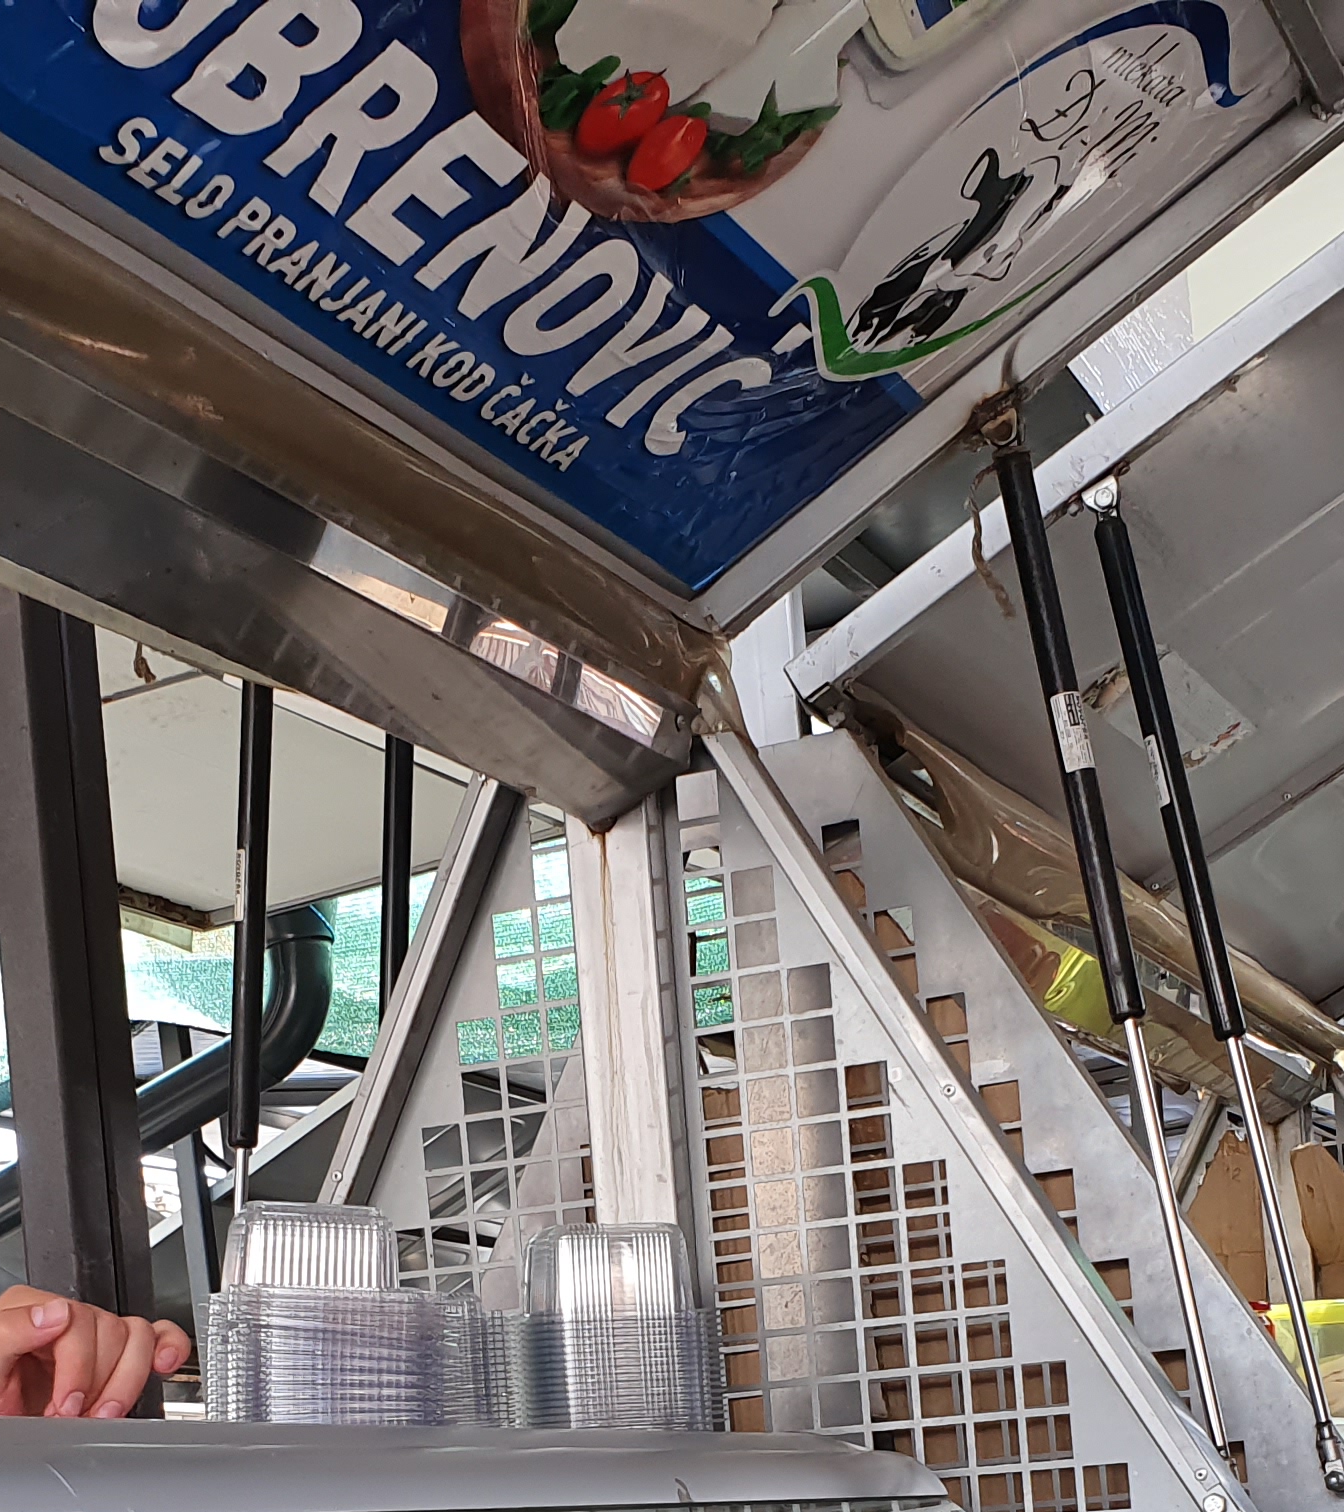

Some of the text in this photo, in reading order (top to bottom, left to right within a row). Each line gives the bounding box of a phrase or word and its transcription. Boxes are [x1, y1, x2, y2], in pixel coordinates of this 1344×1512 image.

[1101, 32, 1187, 108] mlekara
[98, 116, 592, 473] SELO PRANJANI KOD ČAČKA
